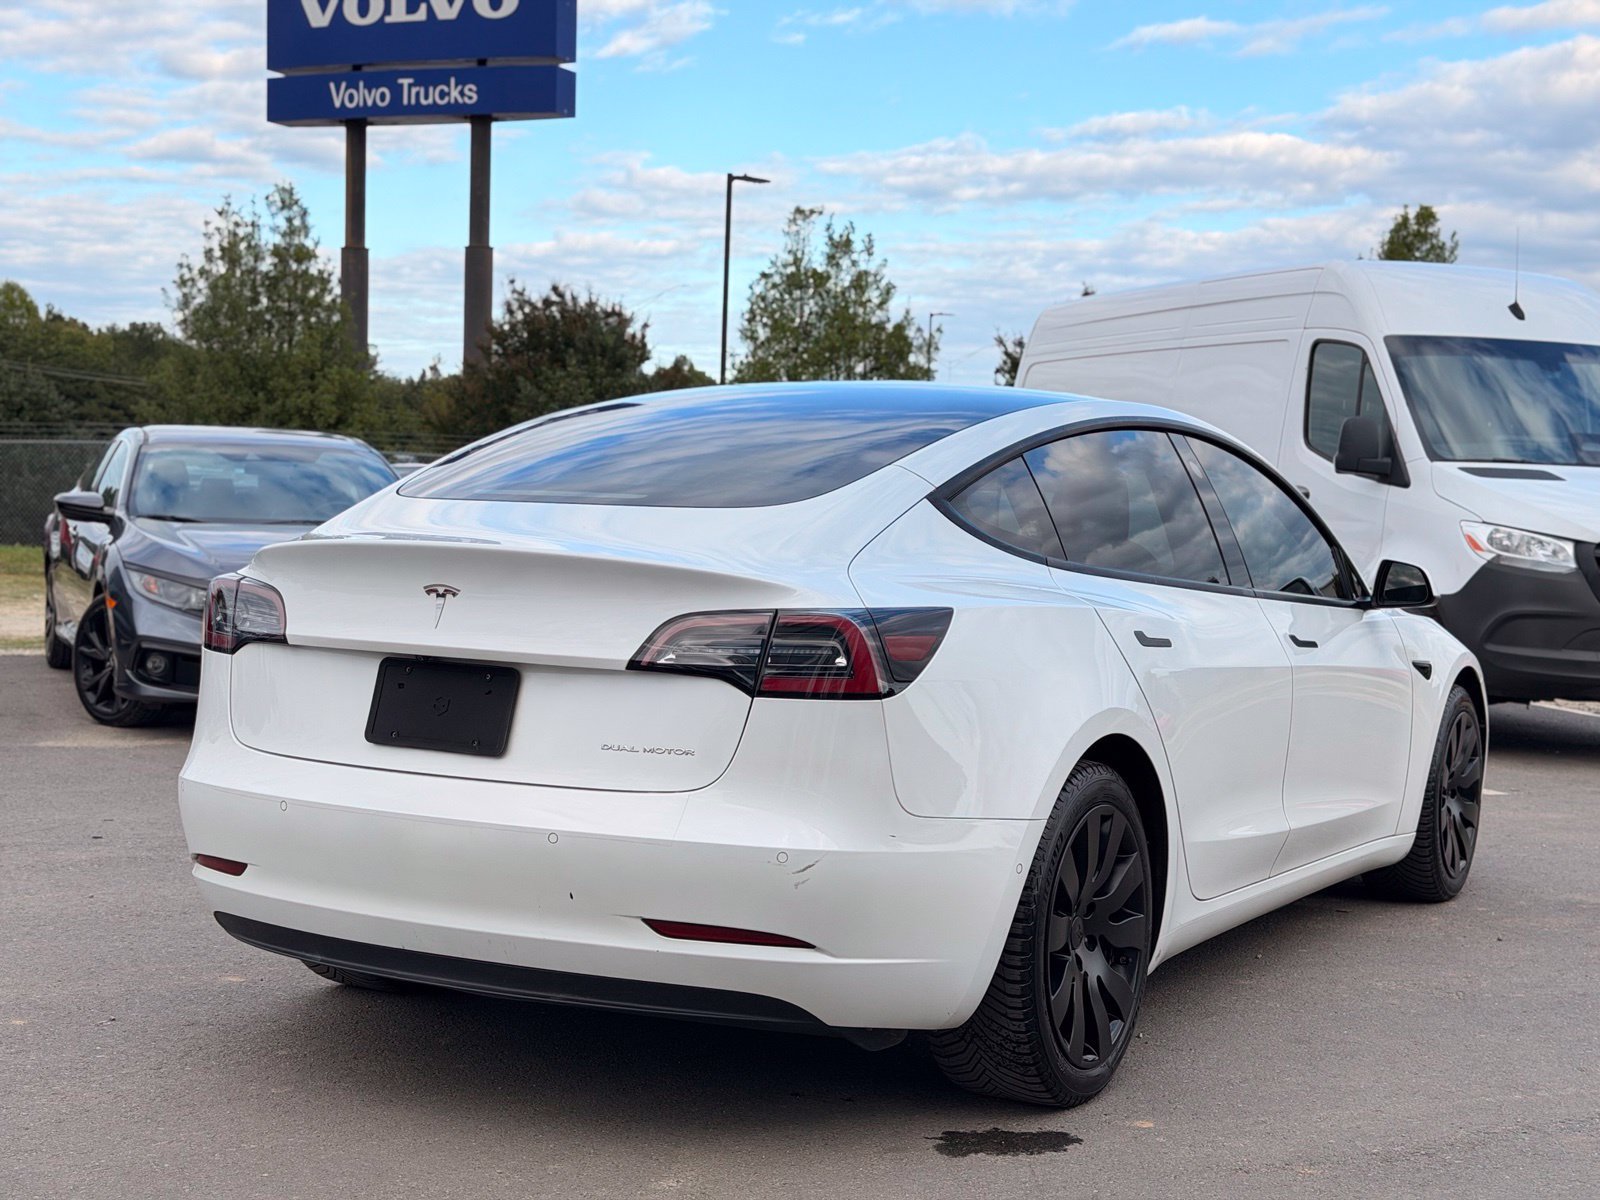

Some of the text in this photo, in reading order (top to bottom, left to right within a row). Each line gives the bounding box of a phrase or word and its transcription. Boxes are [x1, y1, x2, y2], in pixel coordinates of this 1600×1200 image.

[329, 77, 479, 109] Volvo Trucks
[600, 743, 696, 757] DUAL MOTOR
